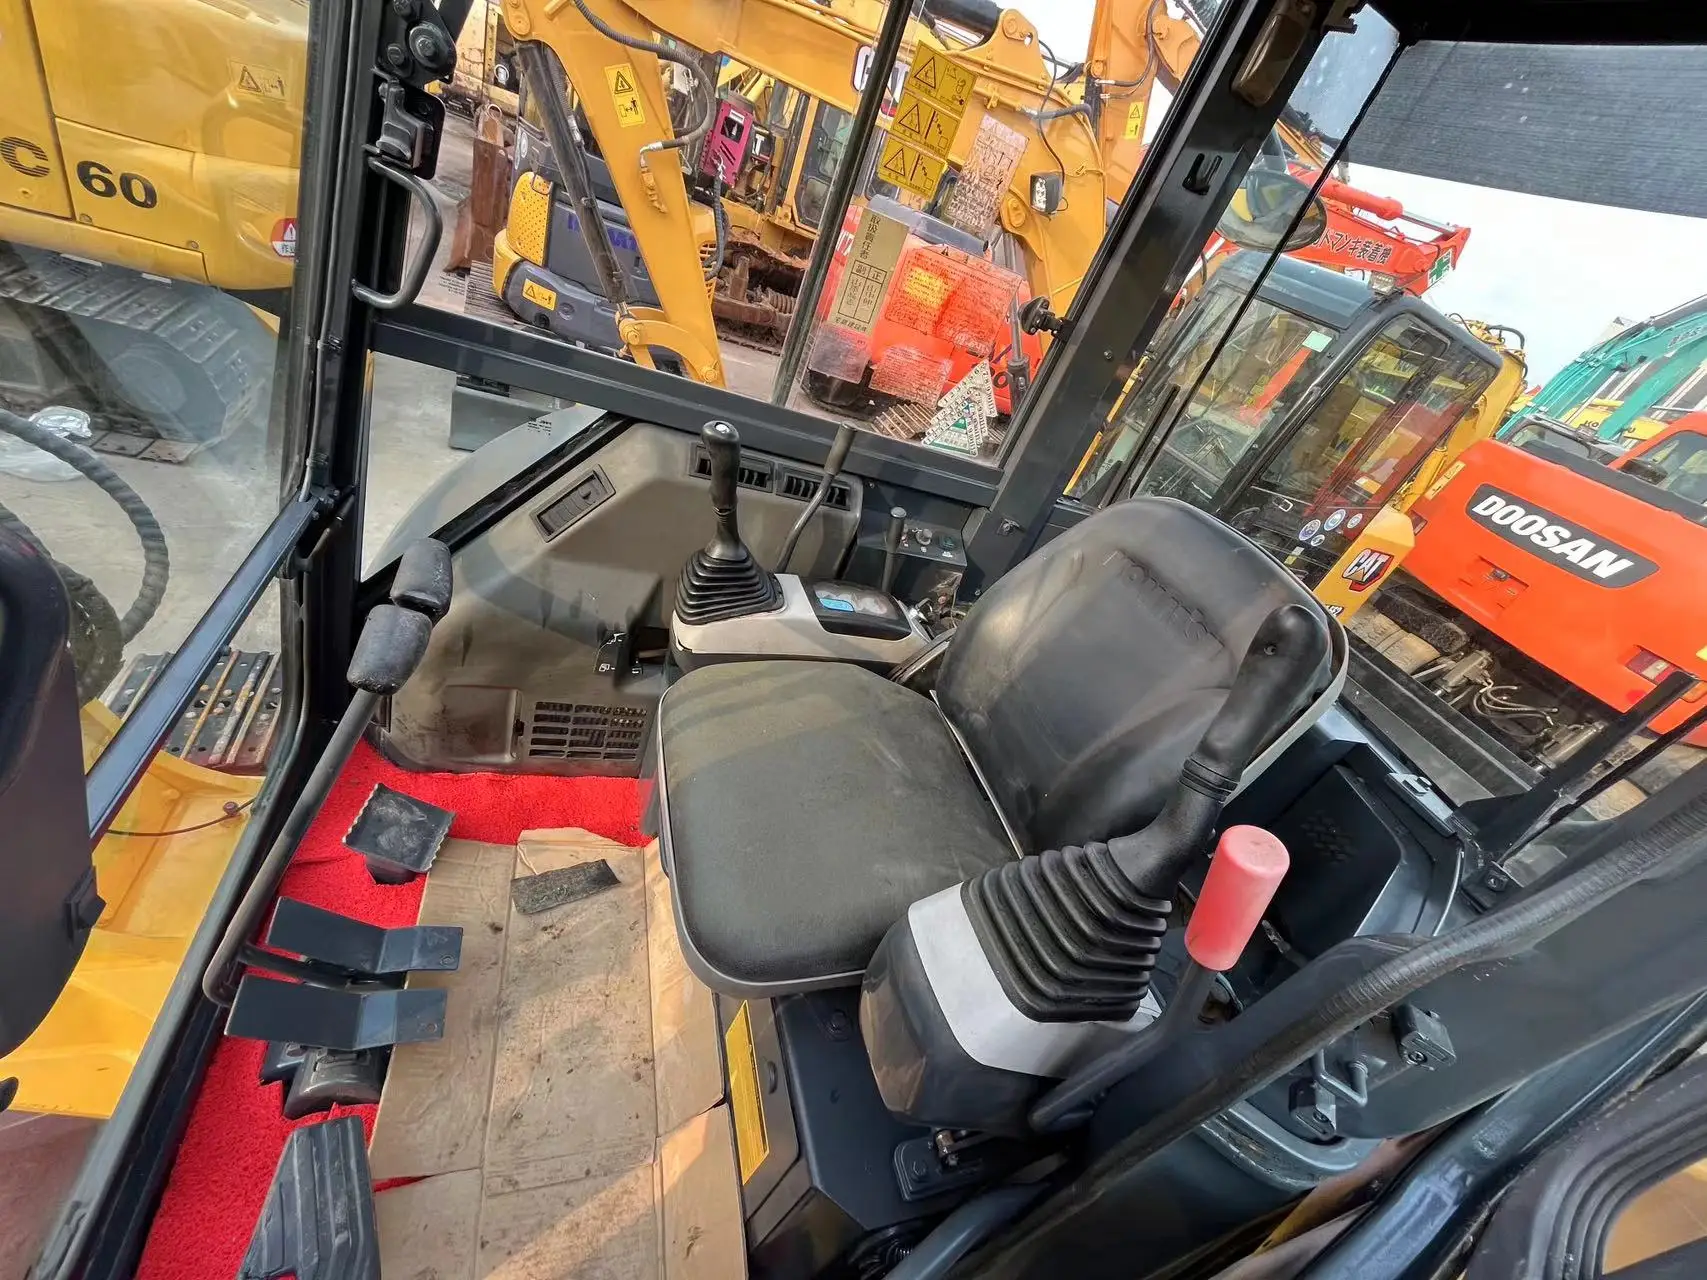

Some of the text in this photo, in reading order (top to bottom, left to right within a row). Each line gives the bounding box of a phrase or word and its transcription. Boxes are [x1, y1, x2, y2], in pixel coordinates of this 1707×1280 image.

[0, 136, 158, 209] C 60
[1342, 548, 1392, 583] CAT
[1471, 494, 1635, 579] DOOSAN
